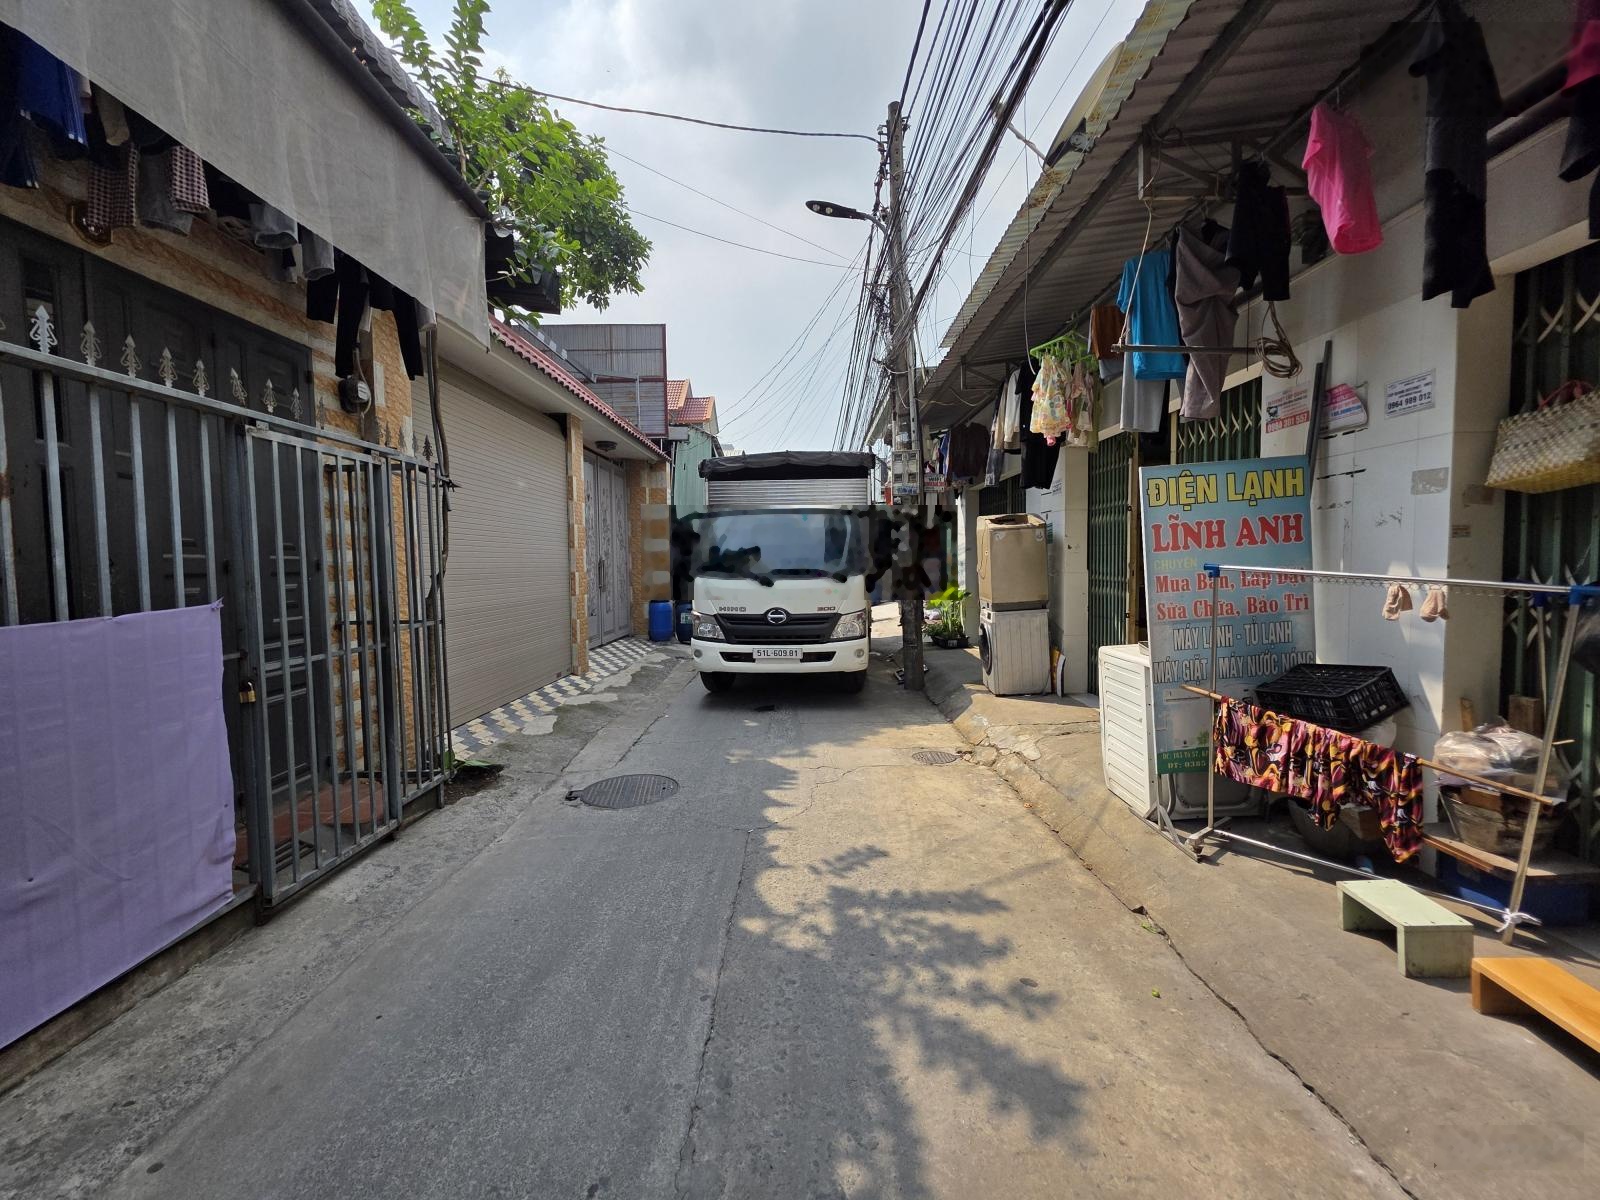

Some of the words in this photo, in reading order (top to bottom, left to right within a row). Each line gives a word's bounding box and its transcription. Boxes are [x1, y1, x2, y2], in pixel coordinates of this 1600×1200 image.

[1147, 469, 1218, 511] ĐIỆN
[1226, 467, 1305, 506] LẠNH
[1151, 513, 1226, 553] LĨNH
[1235, 513, 1305, 547] ANH
[1155, 575, 1190, 593] Mua
[1157, 600, 1187, 621] Sửa
[1173, 623, 1199, 651] MÁY
[1243, 616, 1259, 645] TỦ
[1262, 620, 1293, 648] LẠNH
[1153, 656, 1179, 684] MÁY
[1218, 651, 1244, 679] MÁY
